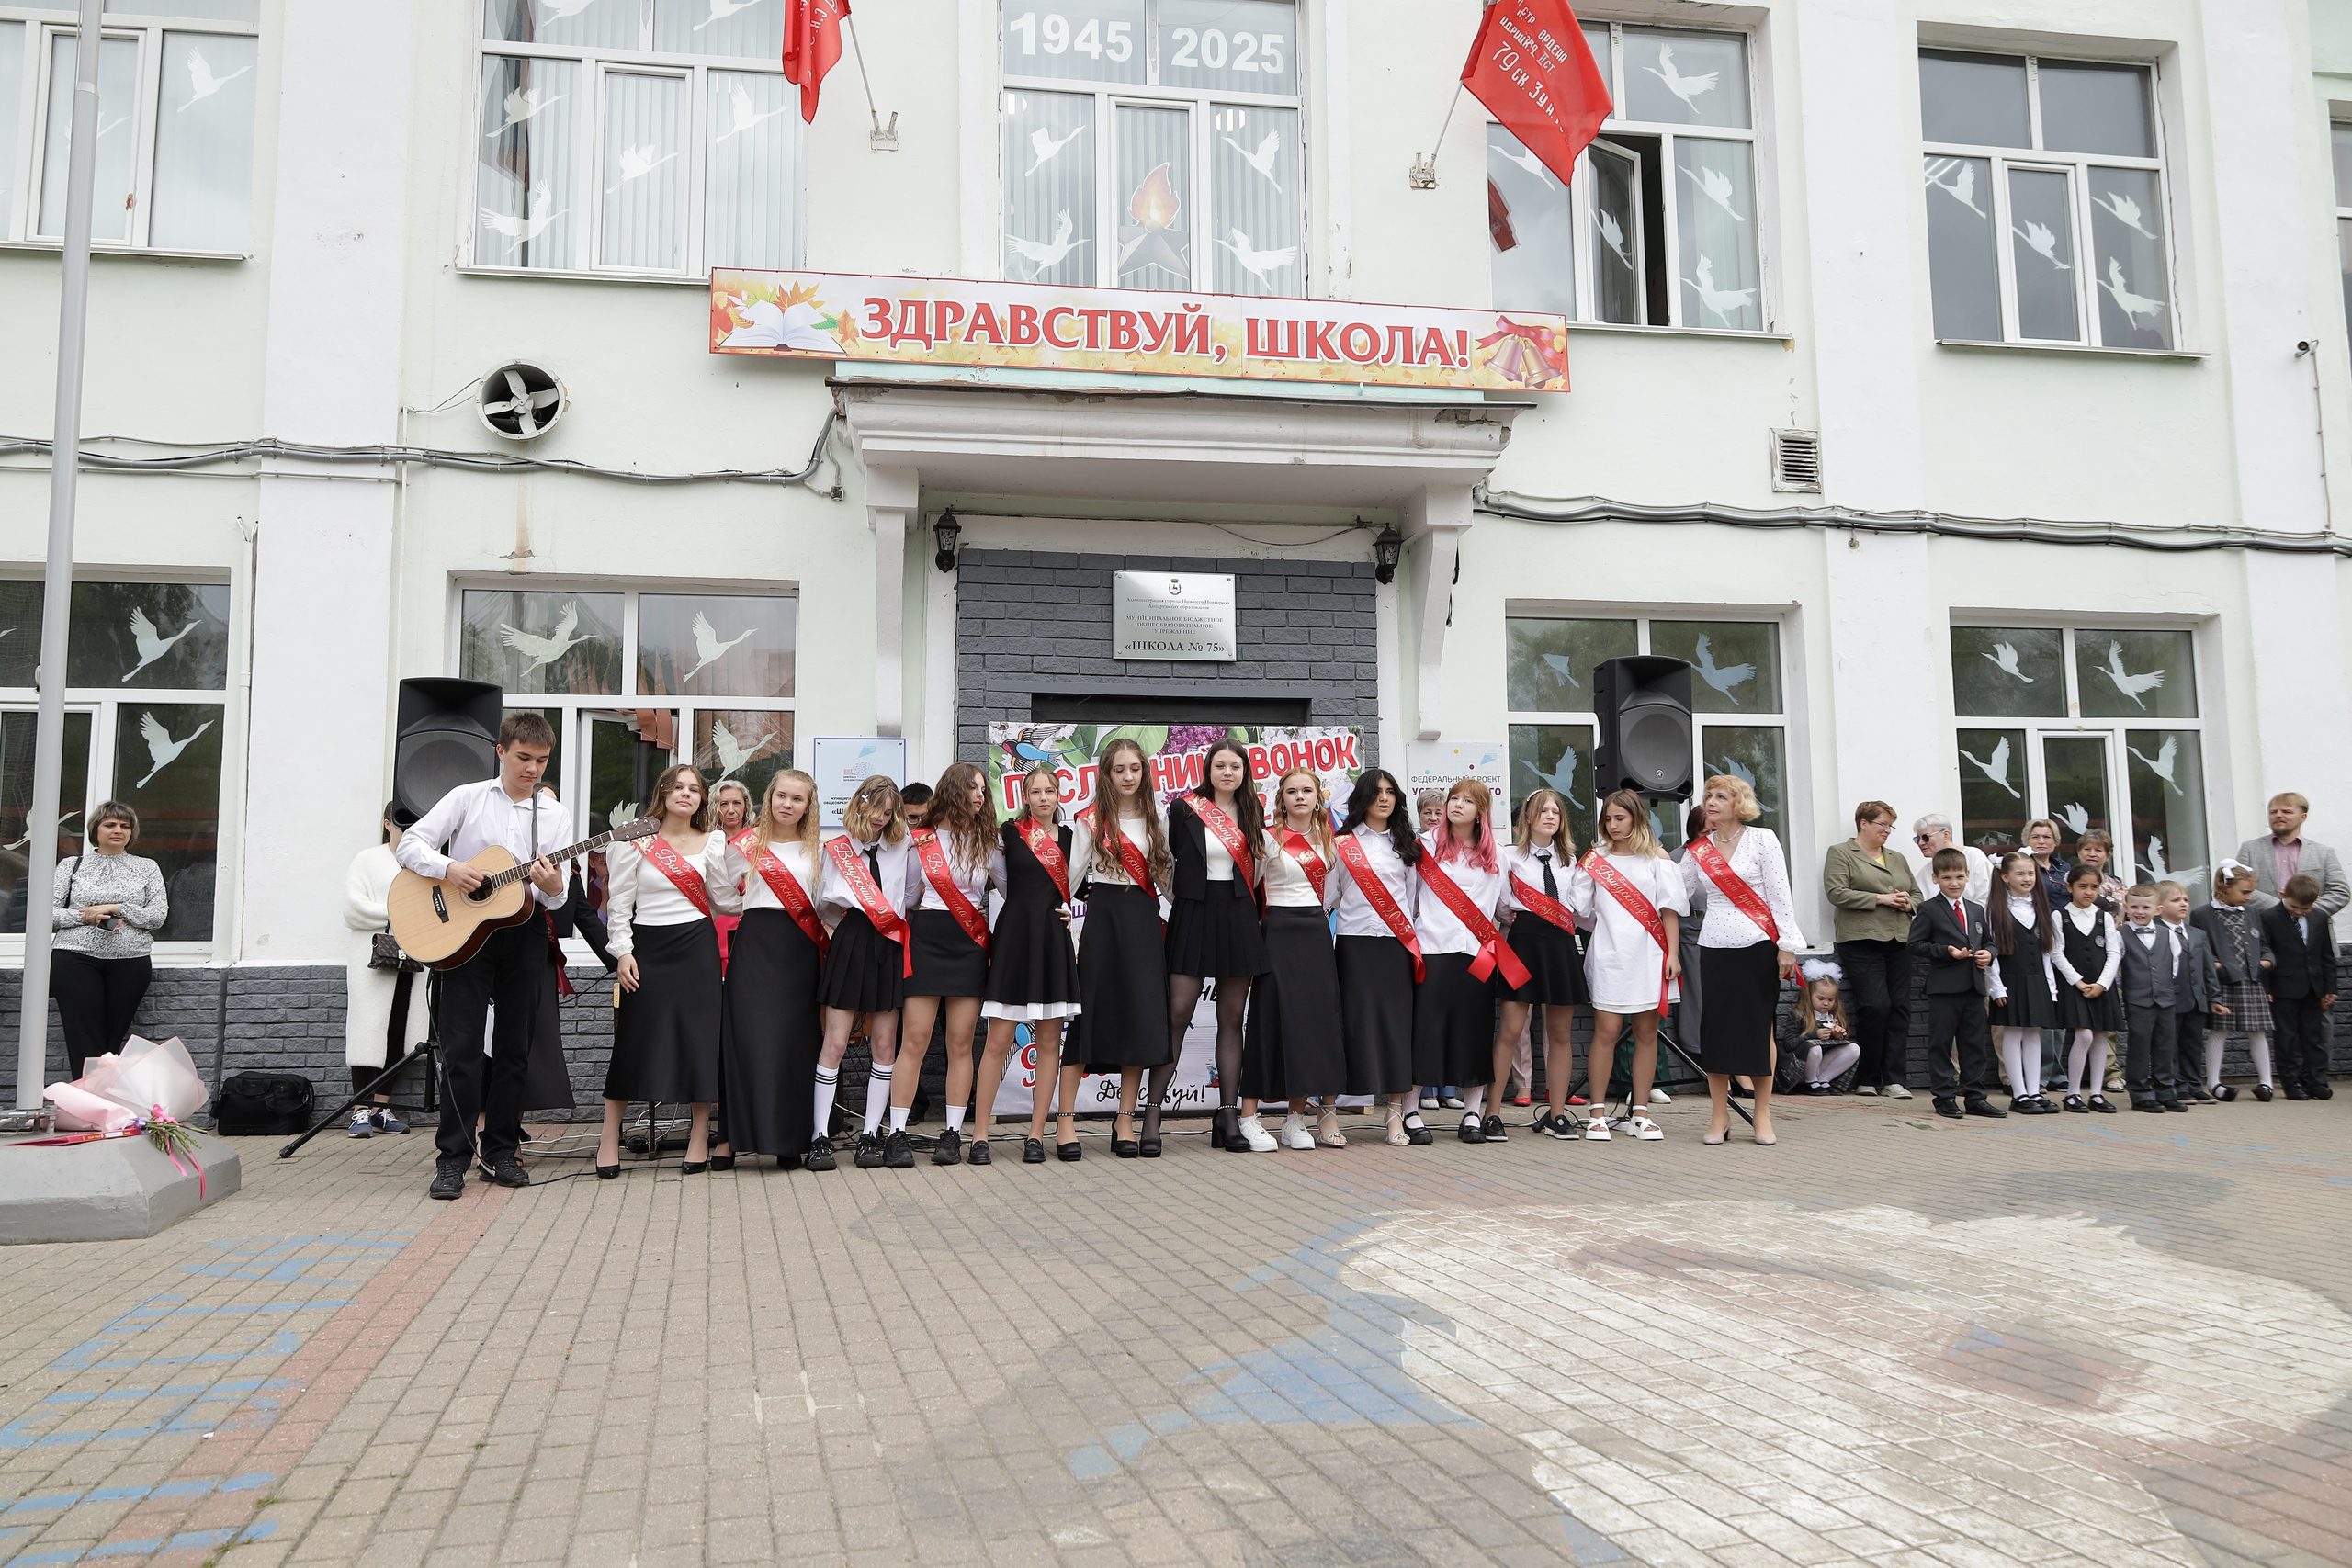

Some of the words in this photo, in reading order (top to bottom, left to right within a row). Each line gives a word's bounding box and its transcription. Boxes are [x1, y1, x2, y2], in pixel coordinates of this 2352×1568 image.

[1010, 12, 1133, 62] 1945
[1171, 28, 1284, 73] 2025
[1492, 40, 1520, 71] 79
[1537, 28, 1568, 63] ОРДЕНА
[861, 297, 1229, 364] ЗДРАВСТВУЙ,
[1245, 317, 1469, 368] ШКОЛА!
[1125, 641, 1183, 651] «ШКОЛА
[1188, 642, 1203, 651] №
[1206, 643, 1225, 652] 75»
[1249, 736, 1358, 781] ВОНОК
[654, 848, 709, 905] Выпускница
[758, 851, 803, 912] Выпускница
[833, 841, 876, 906] Выпускница
[1420, 860, 1468, 915] Выпускница
[1467, 912, 1496, 942] 2025
[1595, 863, 1648, 917] Выпускница
[1382, 904, 1412, 936] 2025
